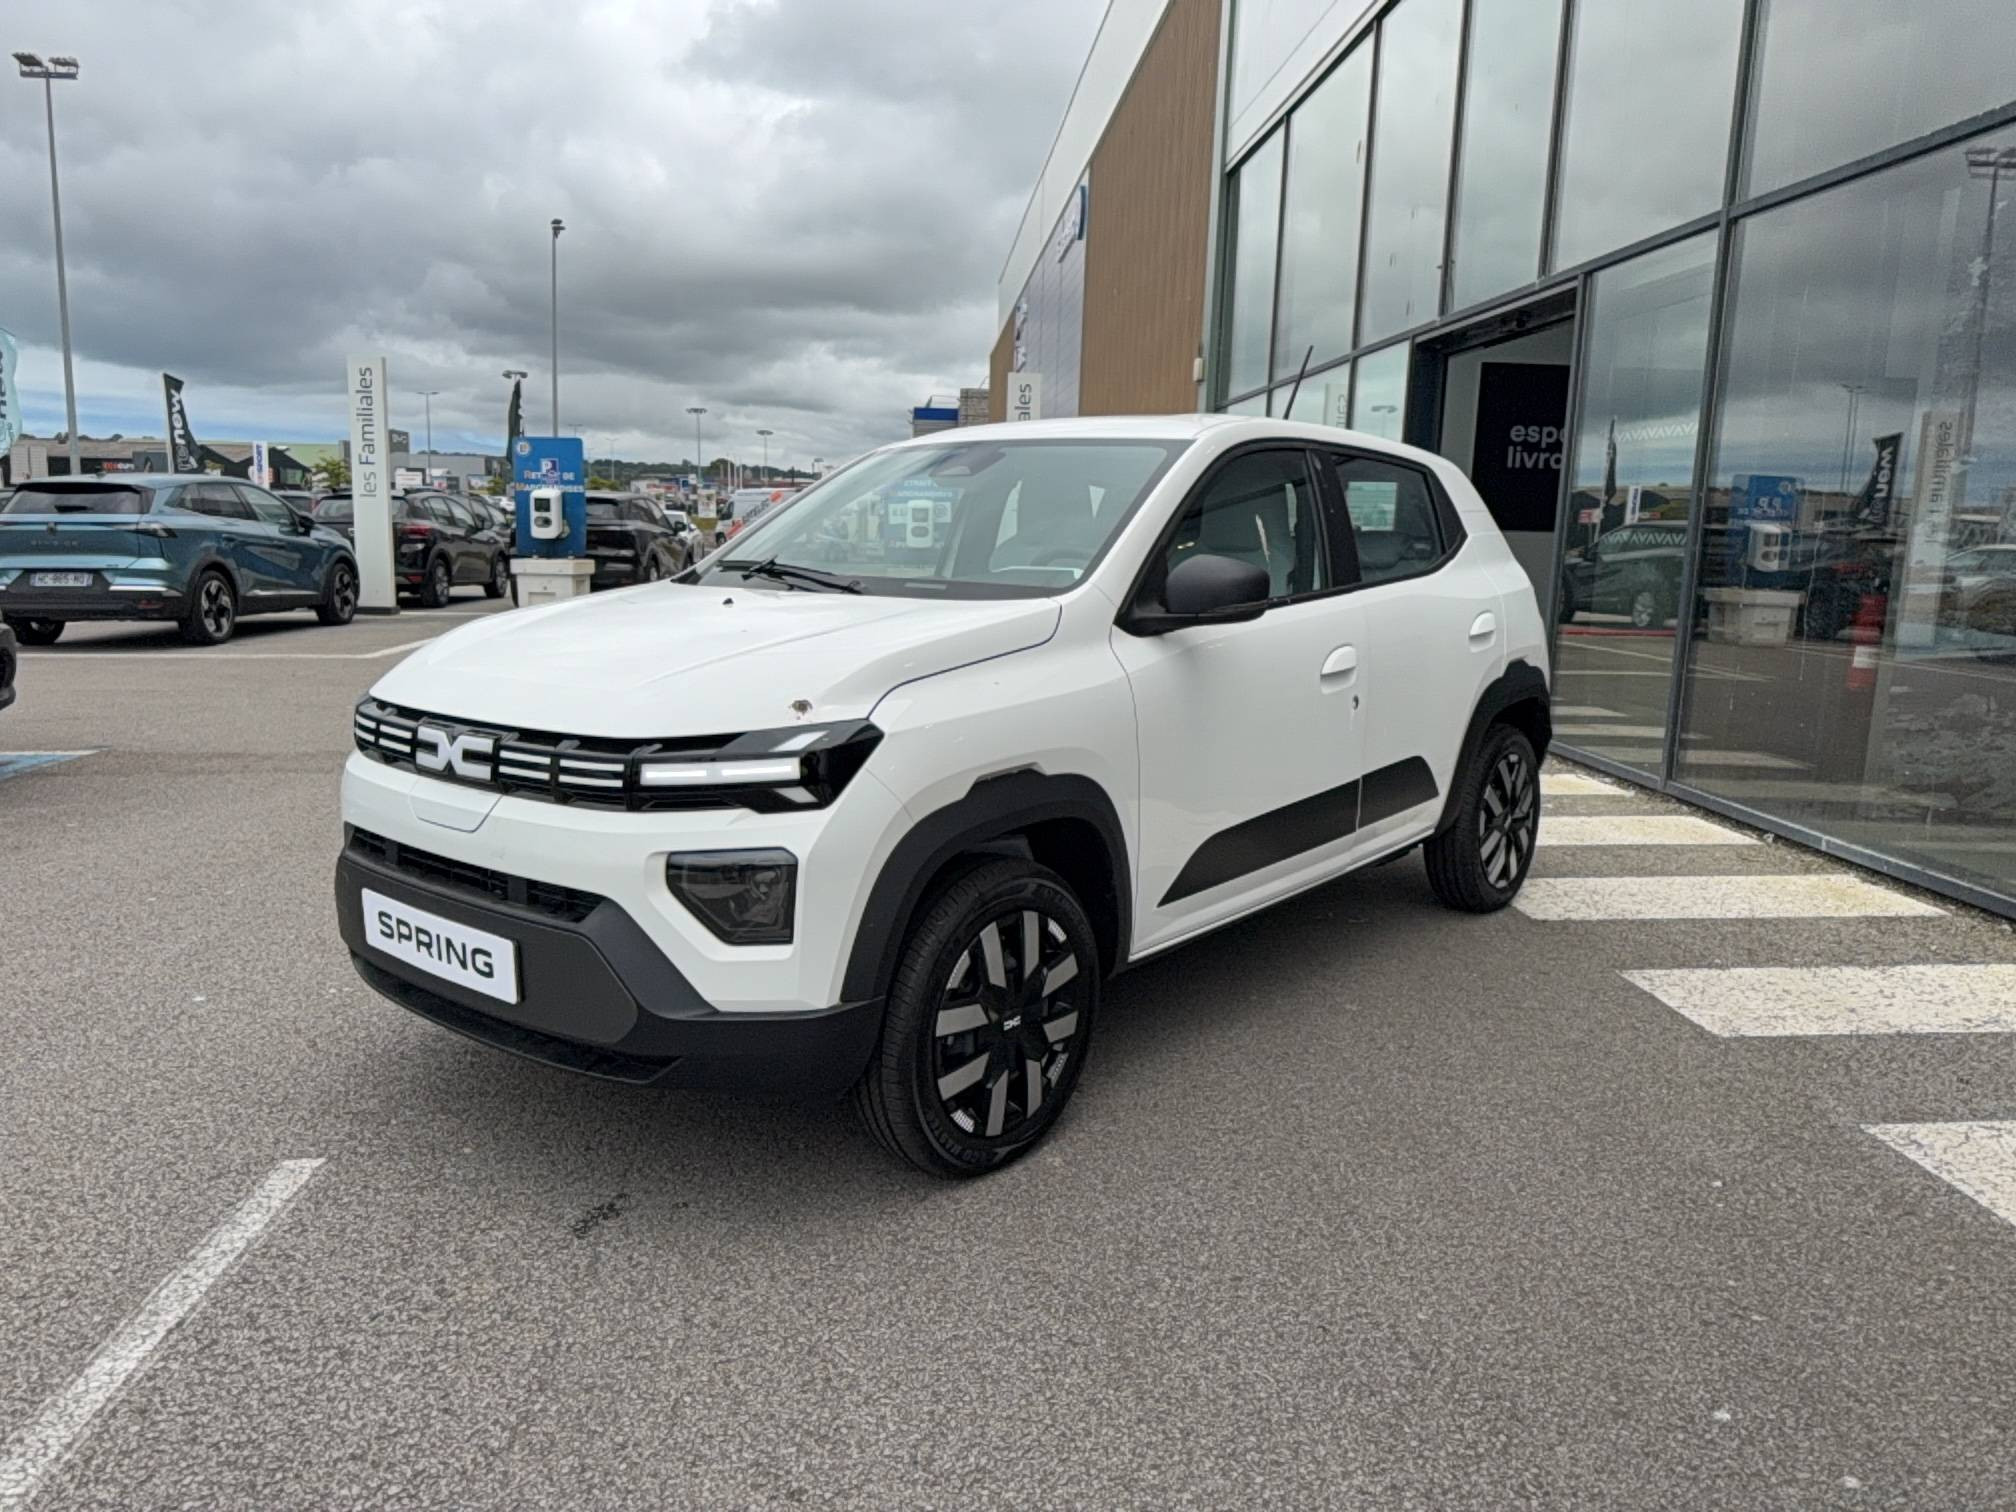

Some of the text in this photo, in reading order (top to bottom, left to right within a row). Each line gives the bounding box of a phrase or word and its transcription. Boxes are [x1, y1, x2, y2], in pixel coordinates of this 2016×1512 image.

[355, 367, 377, 498] les Familiales
[378, 910, 495, 979] SPRING
